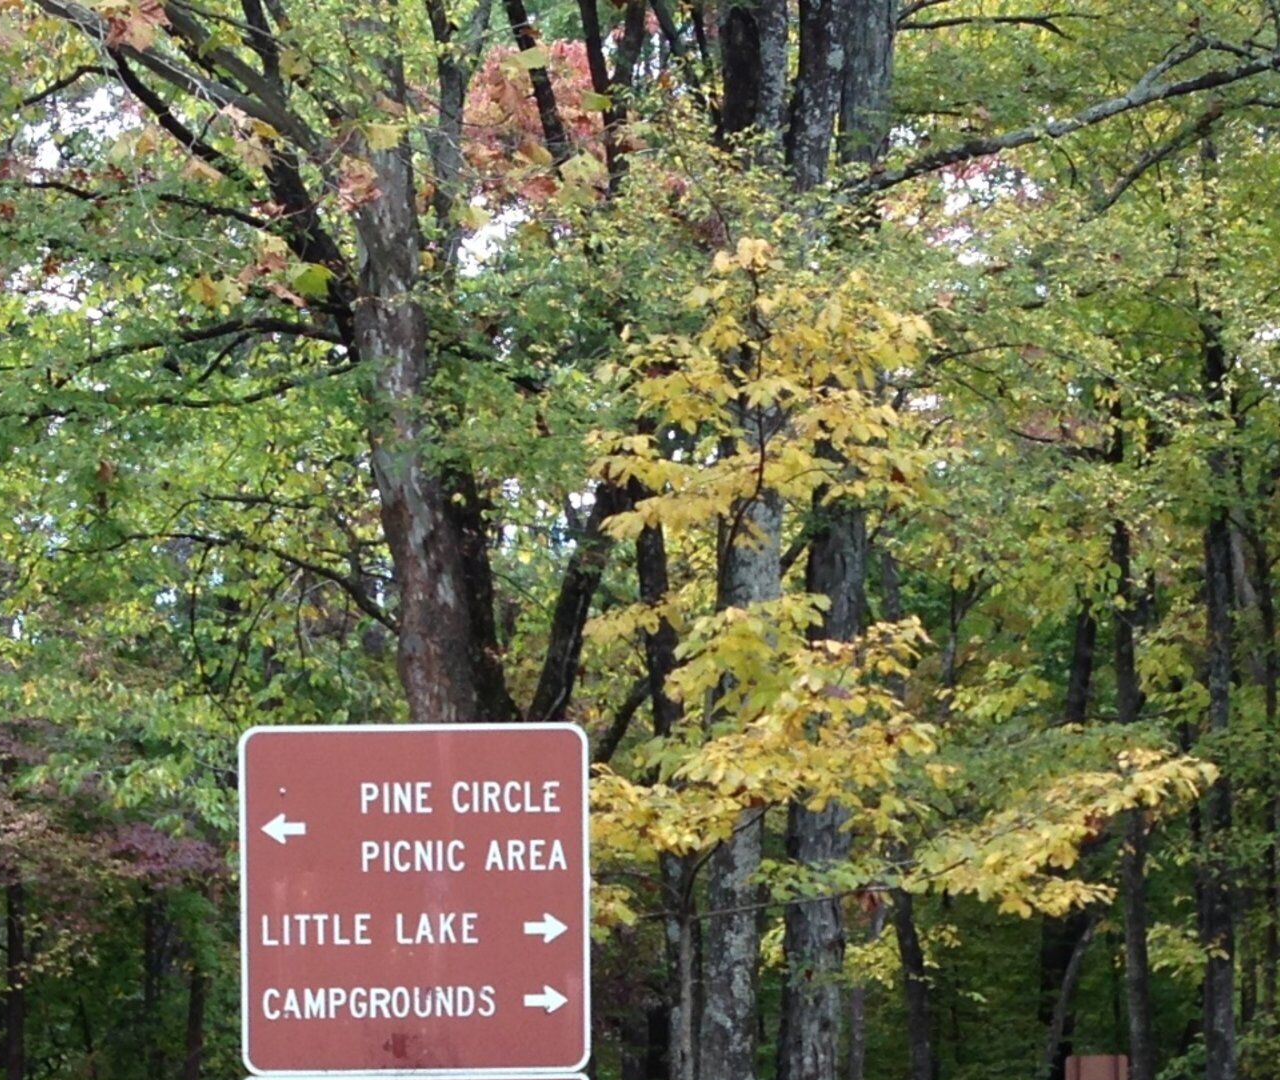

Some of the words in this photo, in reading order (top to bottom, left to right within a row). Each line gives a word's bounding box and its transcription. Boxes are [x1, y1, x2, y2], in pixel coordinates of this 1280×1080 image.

[360, 781, 433, 814] PINE
[451, 780, 561, 814] CIRCLE
[361, 839, 465, 873] PICNIC
[484, 839, 568, 871] AREA
[261, 913, 372, 946] LITTLE
[395, 912, 479, 945] LAKE
[262, 985, 496, 1020] CAMPGROUNDS
